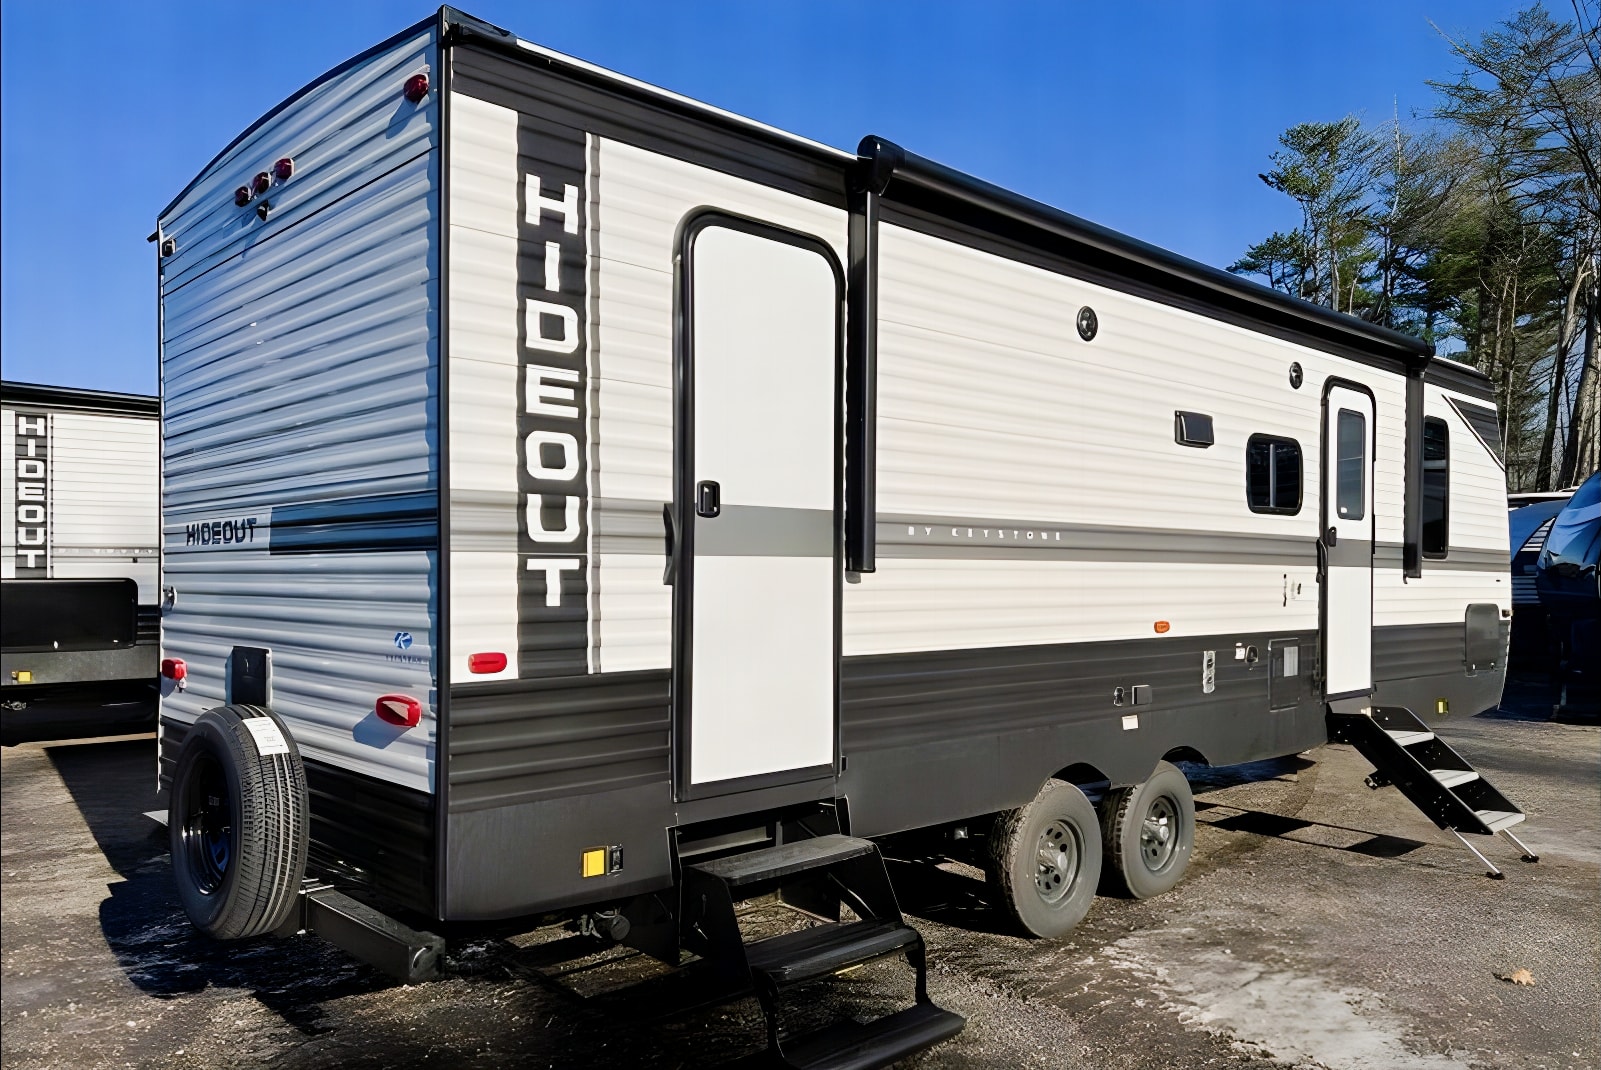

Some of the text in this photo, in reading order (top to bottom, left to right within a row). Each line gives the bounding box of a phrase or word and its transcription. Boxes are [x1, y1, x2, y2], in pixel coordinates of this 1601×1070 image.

[525, 173, 580, 607] HIDEOUT
[18, 416, 46, 568] HIDEOUT
[186, 517, 257, 546] HIDEOUT
